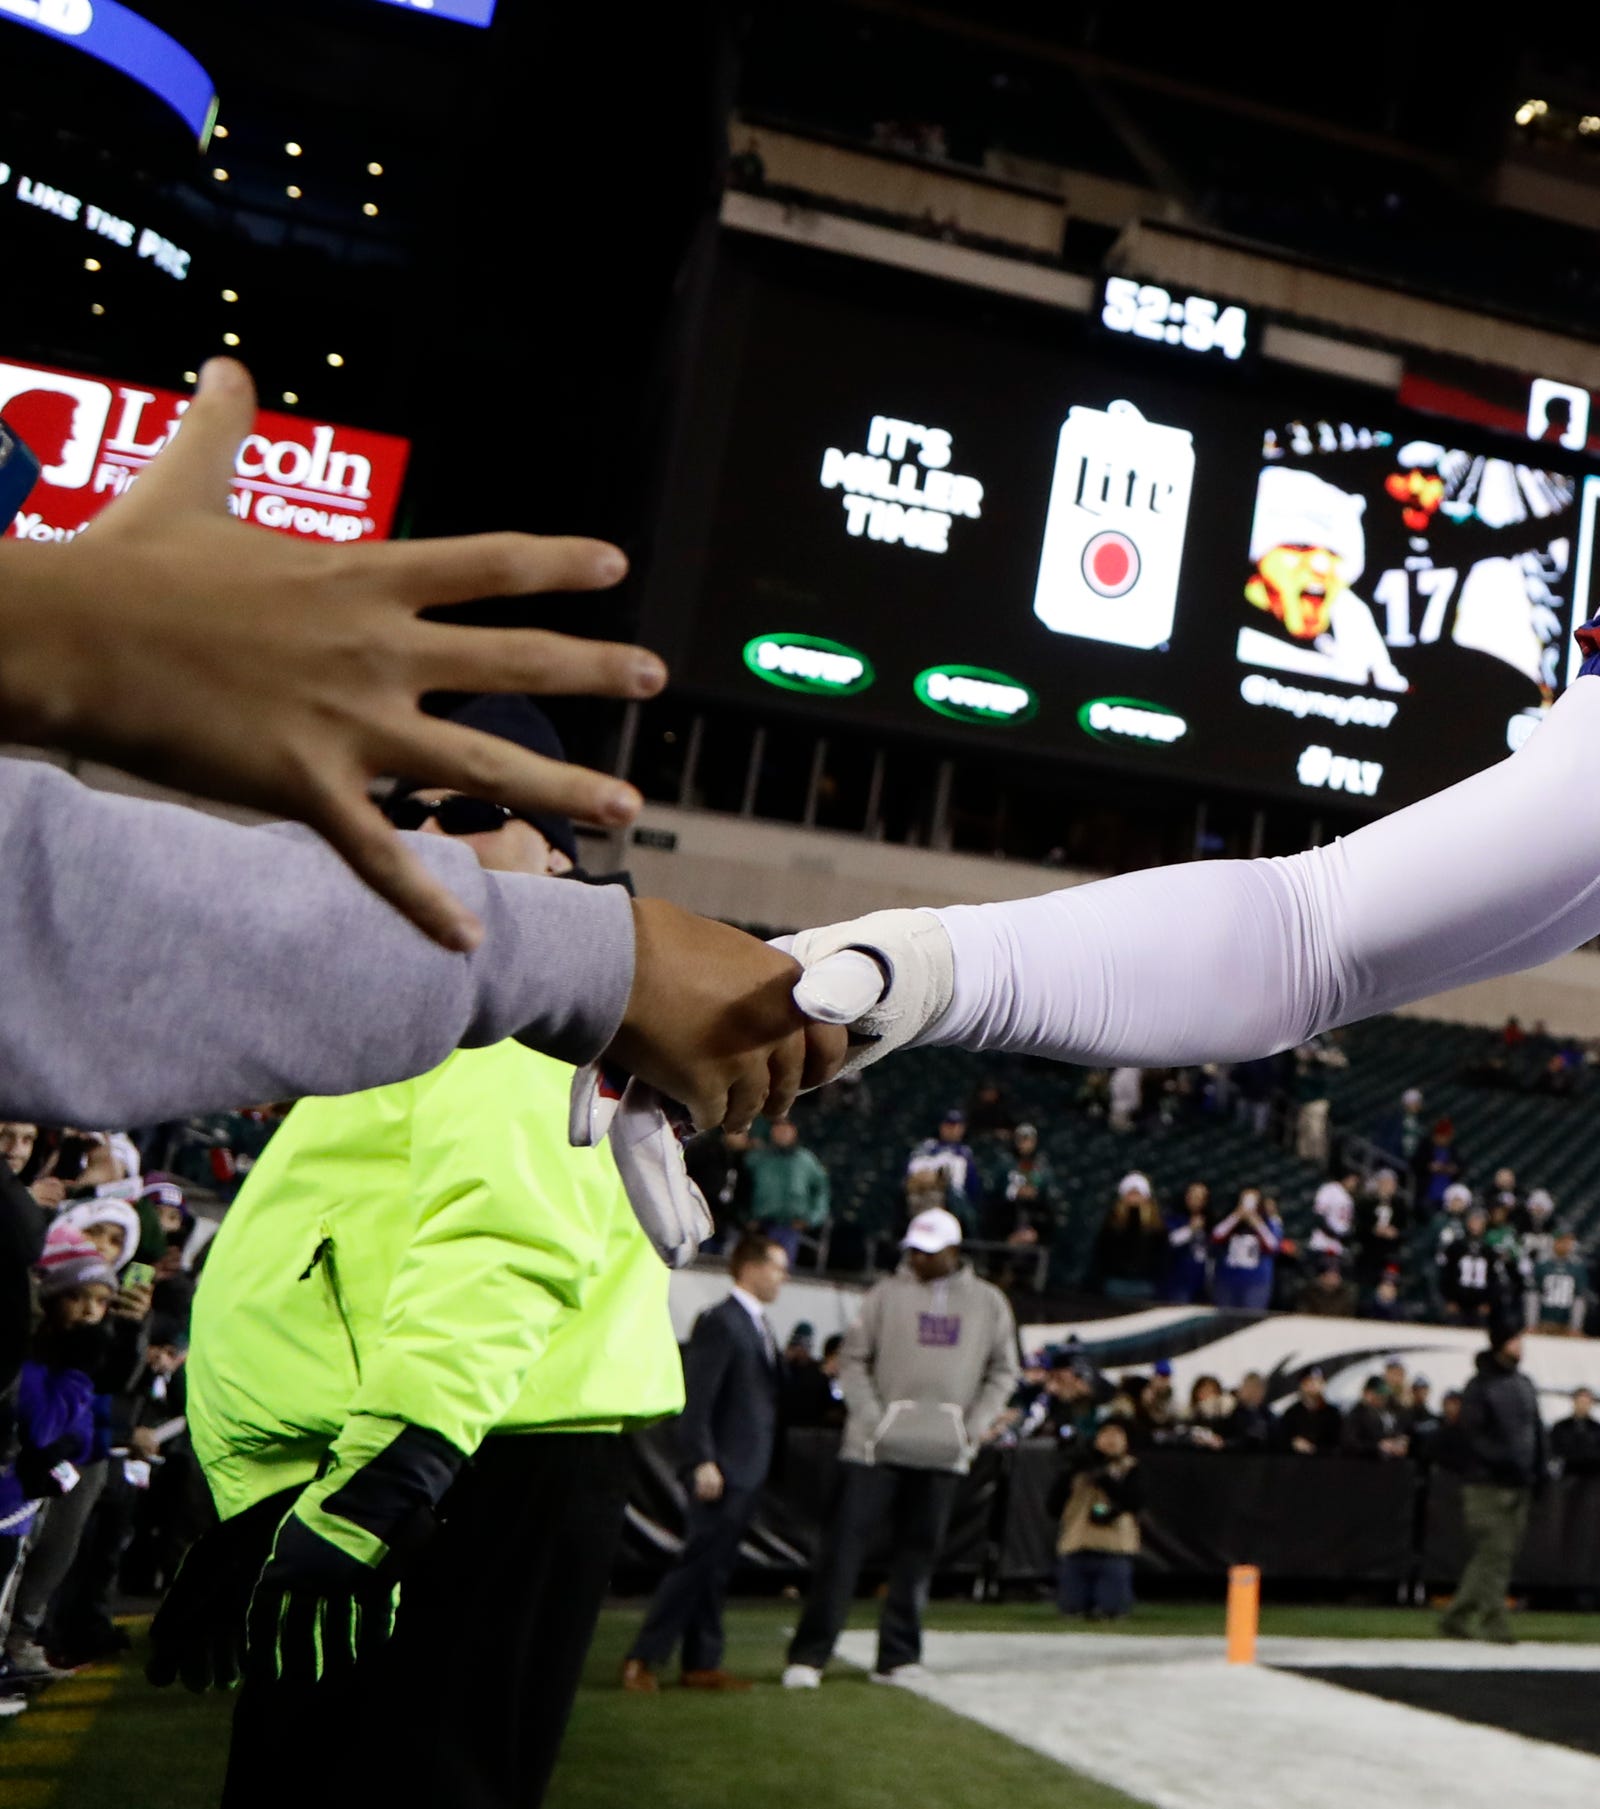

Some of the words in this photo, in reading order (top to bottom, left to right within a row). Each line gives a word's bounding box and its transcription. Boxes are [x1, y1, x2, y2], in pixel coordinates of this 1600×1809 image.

[17, 176, 82, 222] LIKE
[1102, 276, 1248, 360] 52:54
[105, 386, 372, 500] Licoln
[867, 415, 953, 469] IT'S
[820, 447, 984, 519] MILLER
[842, 493, 953, 554] TIME
[1296, 745, 1384, 796] #FLY
